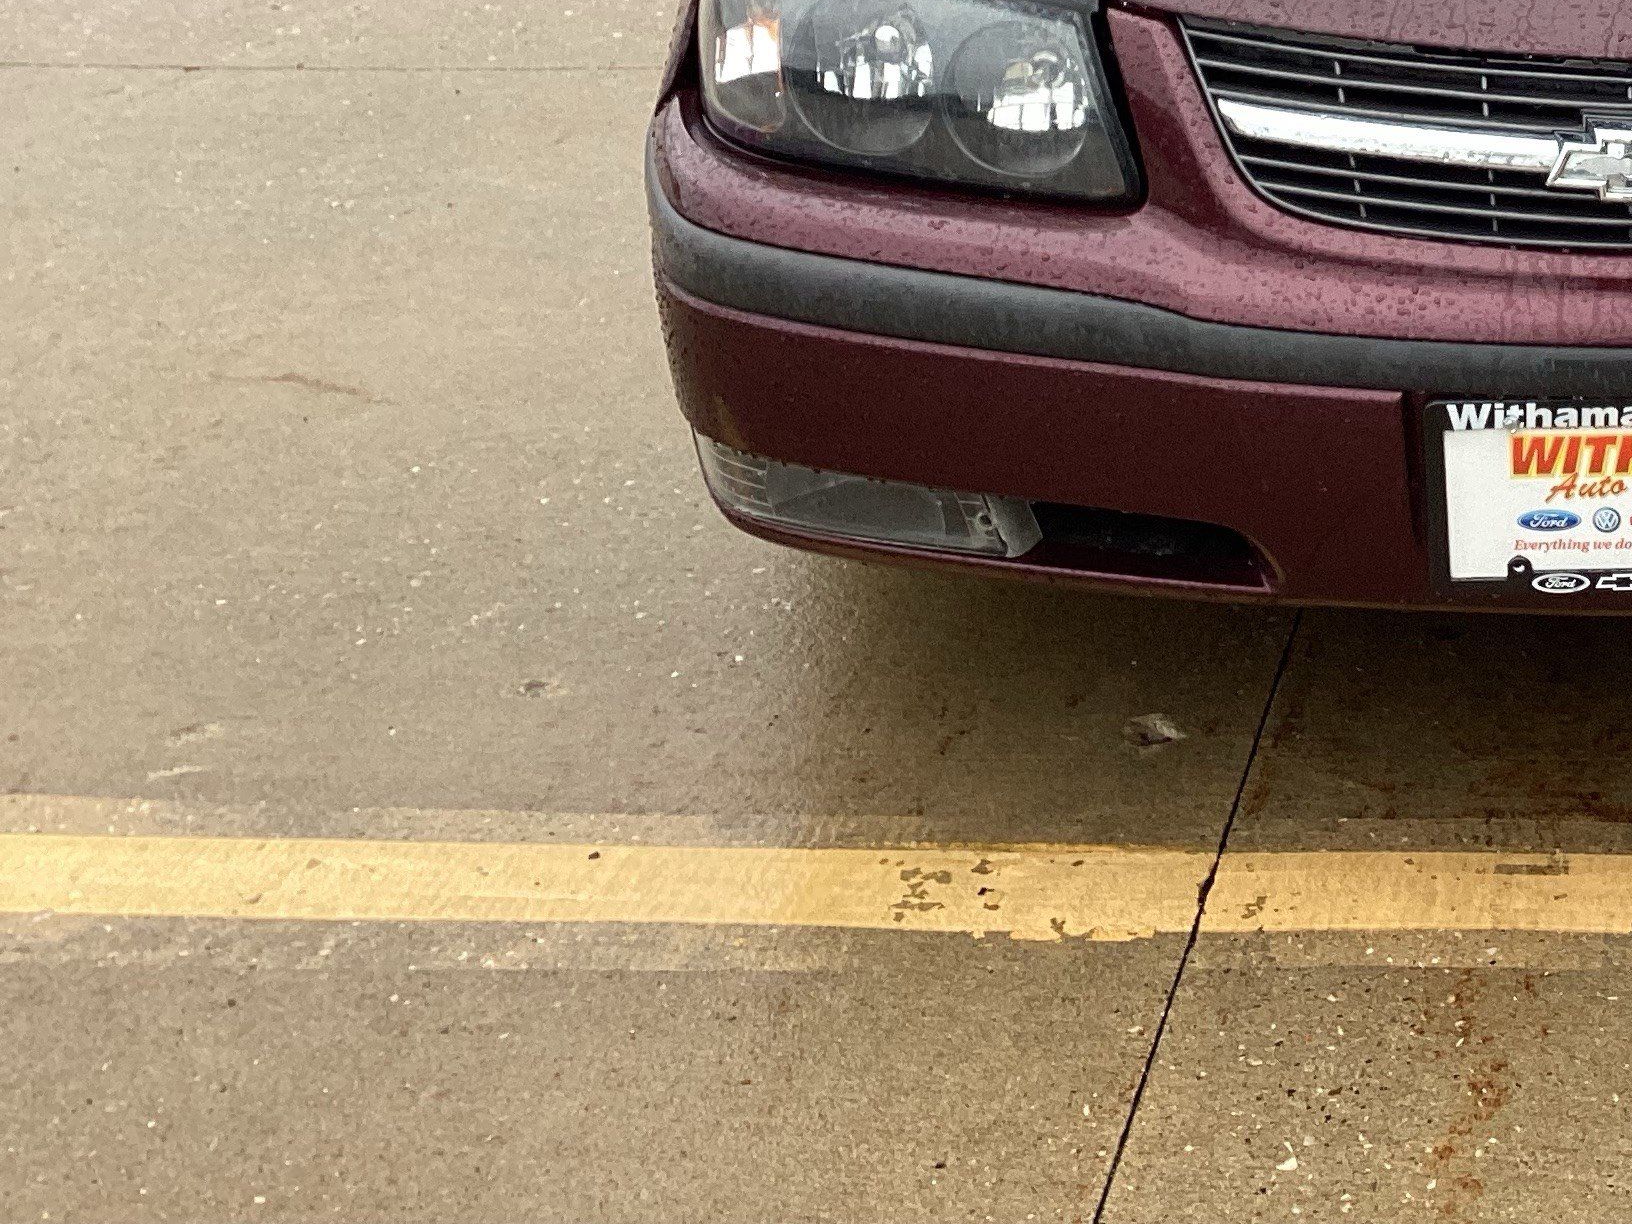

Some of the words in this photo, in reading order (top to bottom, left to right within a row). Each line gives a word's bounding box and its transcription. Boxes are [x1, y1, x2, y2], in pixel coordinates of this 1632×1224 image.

[1544, 472, 1627, 504] Auto
[1513, 538, 1590, 553] Everything
[1592, 539, 1613, 550] we
[1615, 537, 1632, 550] do
